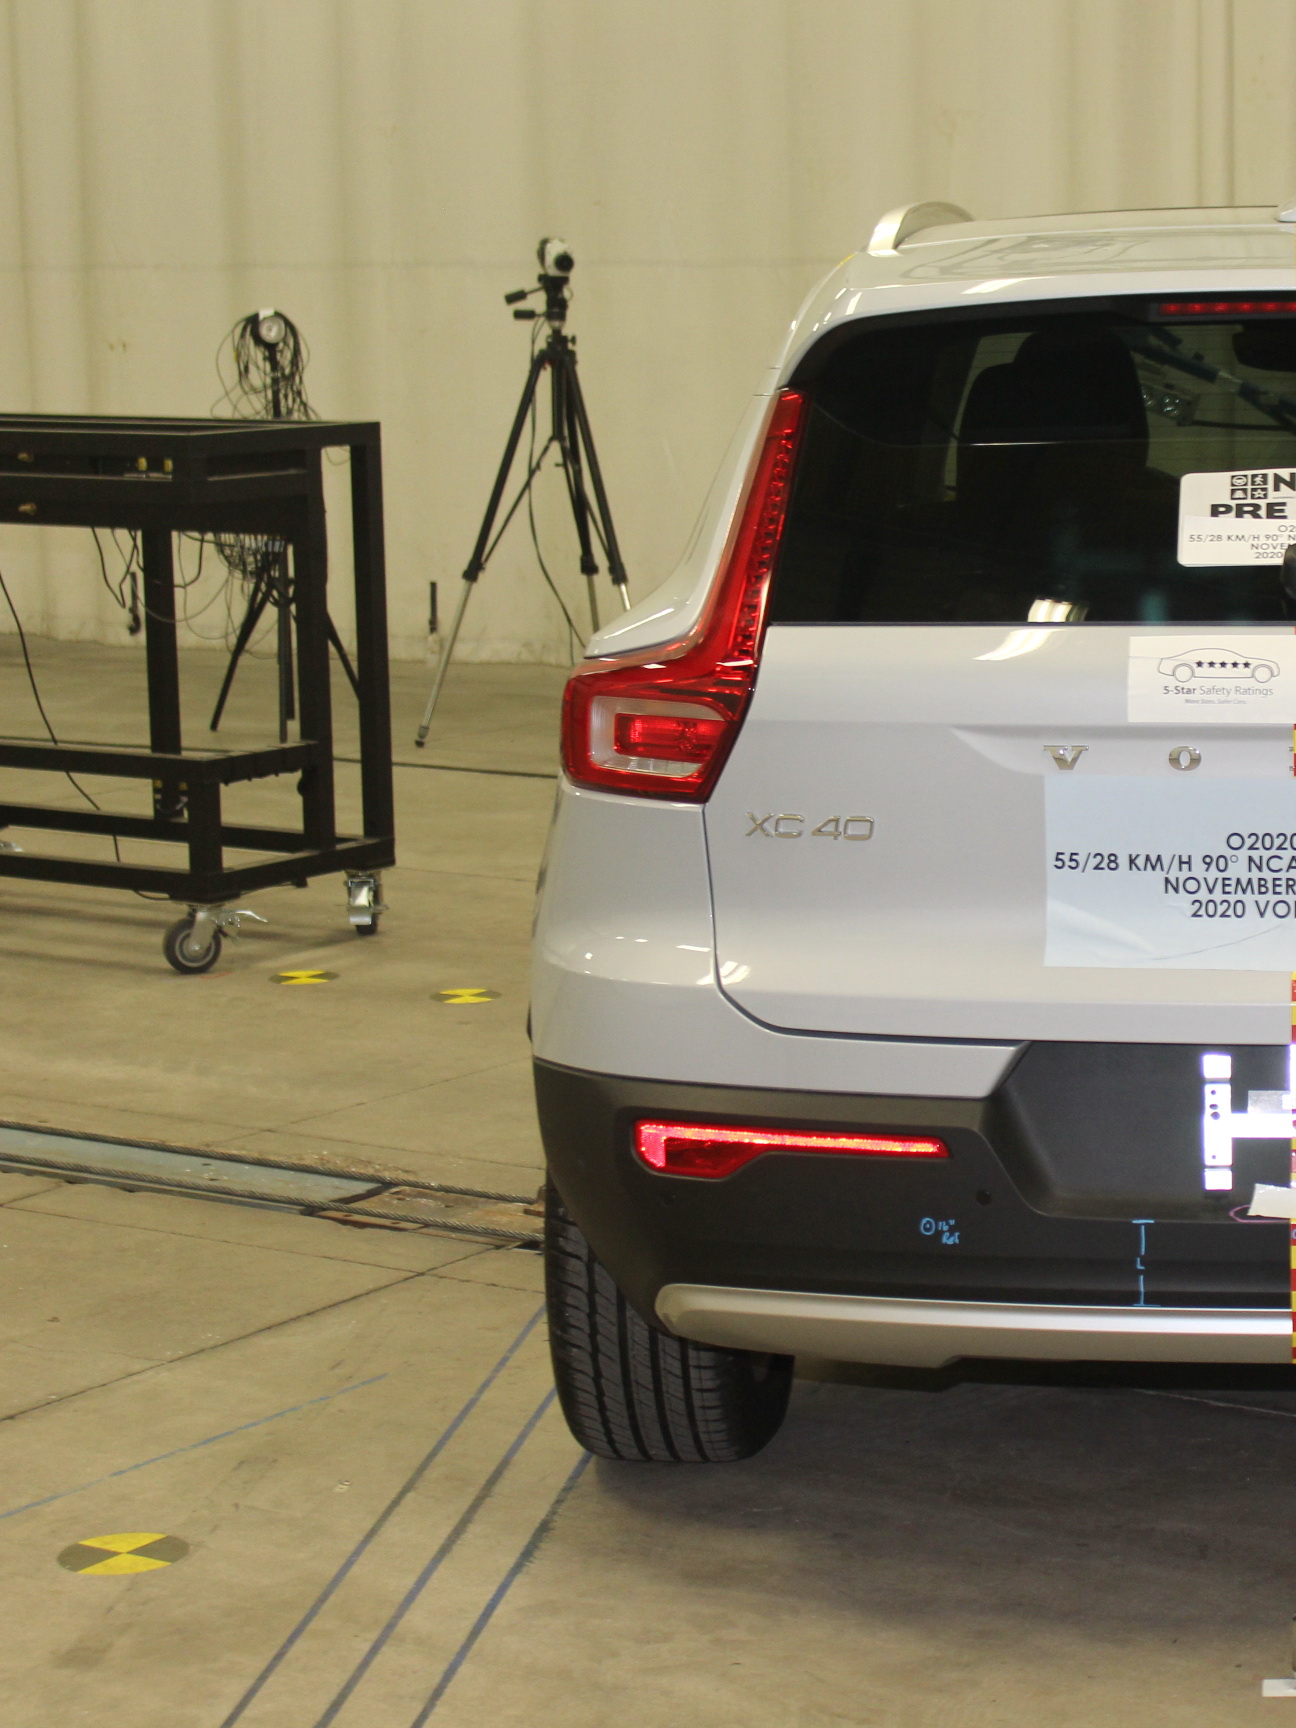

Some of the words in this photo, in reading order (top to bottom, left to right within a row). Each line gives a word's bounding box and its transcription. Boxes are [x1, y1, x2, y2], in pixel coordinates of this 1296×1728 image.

[1210, 502, 1288, 519] PRE
[1189, 534, 1223, 542] 55/28
[1227, 534, 1260, 543] KM/H
[1255, 551, 1283, 559] 2020
[1163, 685, 1197, 695] 5-Star
[1200, 685, 1232, 697] Safety
[1234, 685, 1274, 698] Ratings
[1053, 852, 1119, 873] 55/28
[1128, 854, 1192, 874] KM/H
[1164, 877, 1296, 895] NOVEMBER
[1191, 900, 1246, 918] 2020
